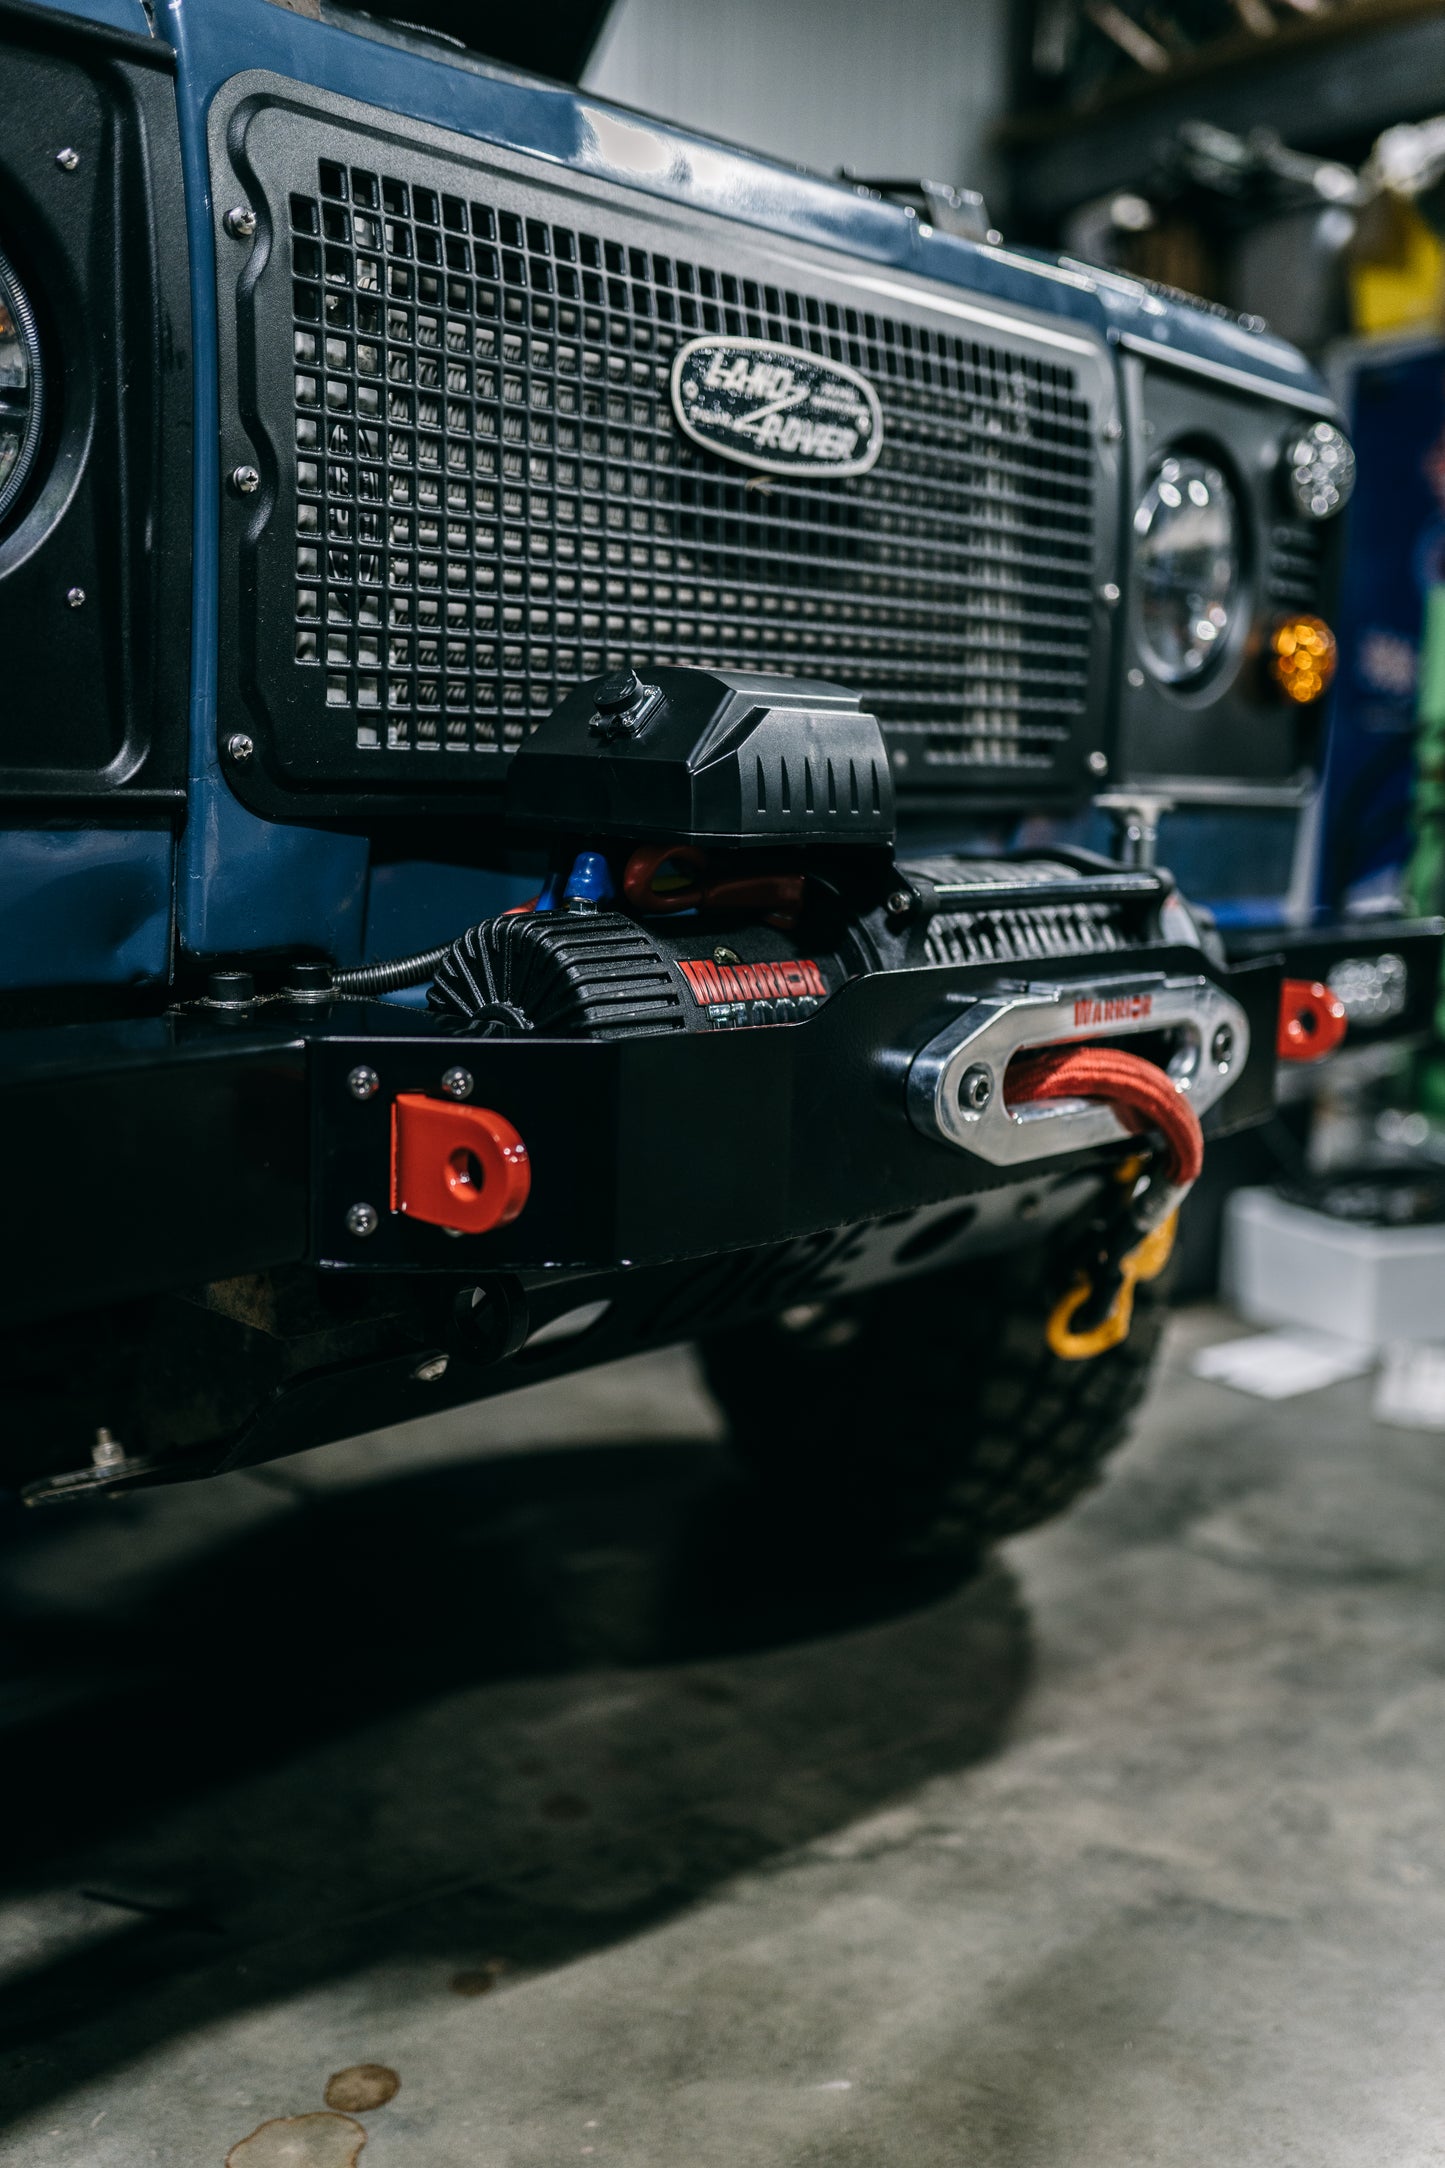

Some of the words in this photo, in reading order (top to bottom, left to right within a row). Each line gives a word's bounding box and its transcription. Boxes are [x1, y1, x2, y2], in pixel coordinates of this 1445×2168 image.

[703, 353, 795, 400] LAND
[756, 414, 858, 459] ROVER
[677, 959, 827, 1005] WARRIOR
[1074, 994, 1152, 1028] WARRIOR
